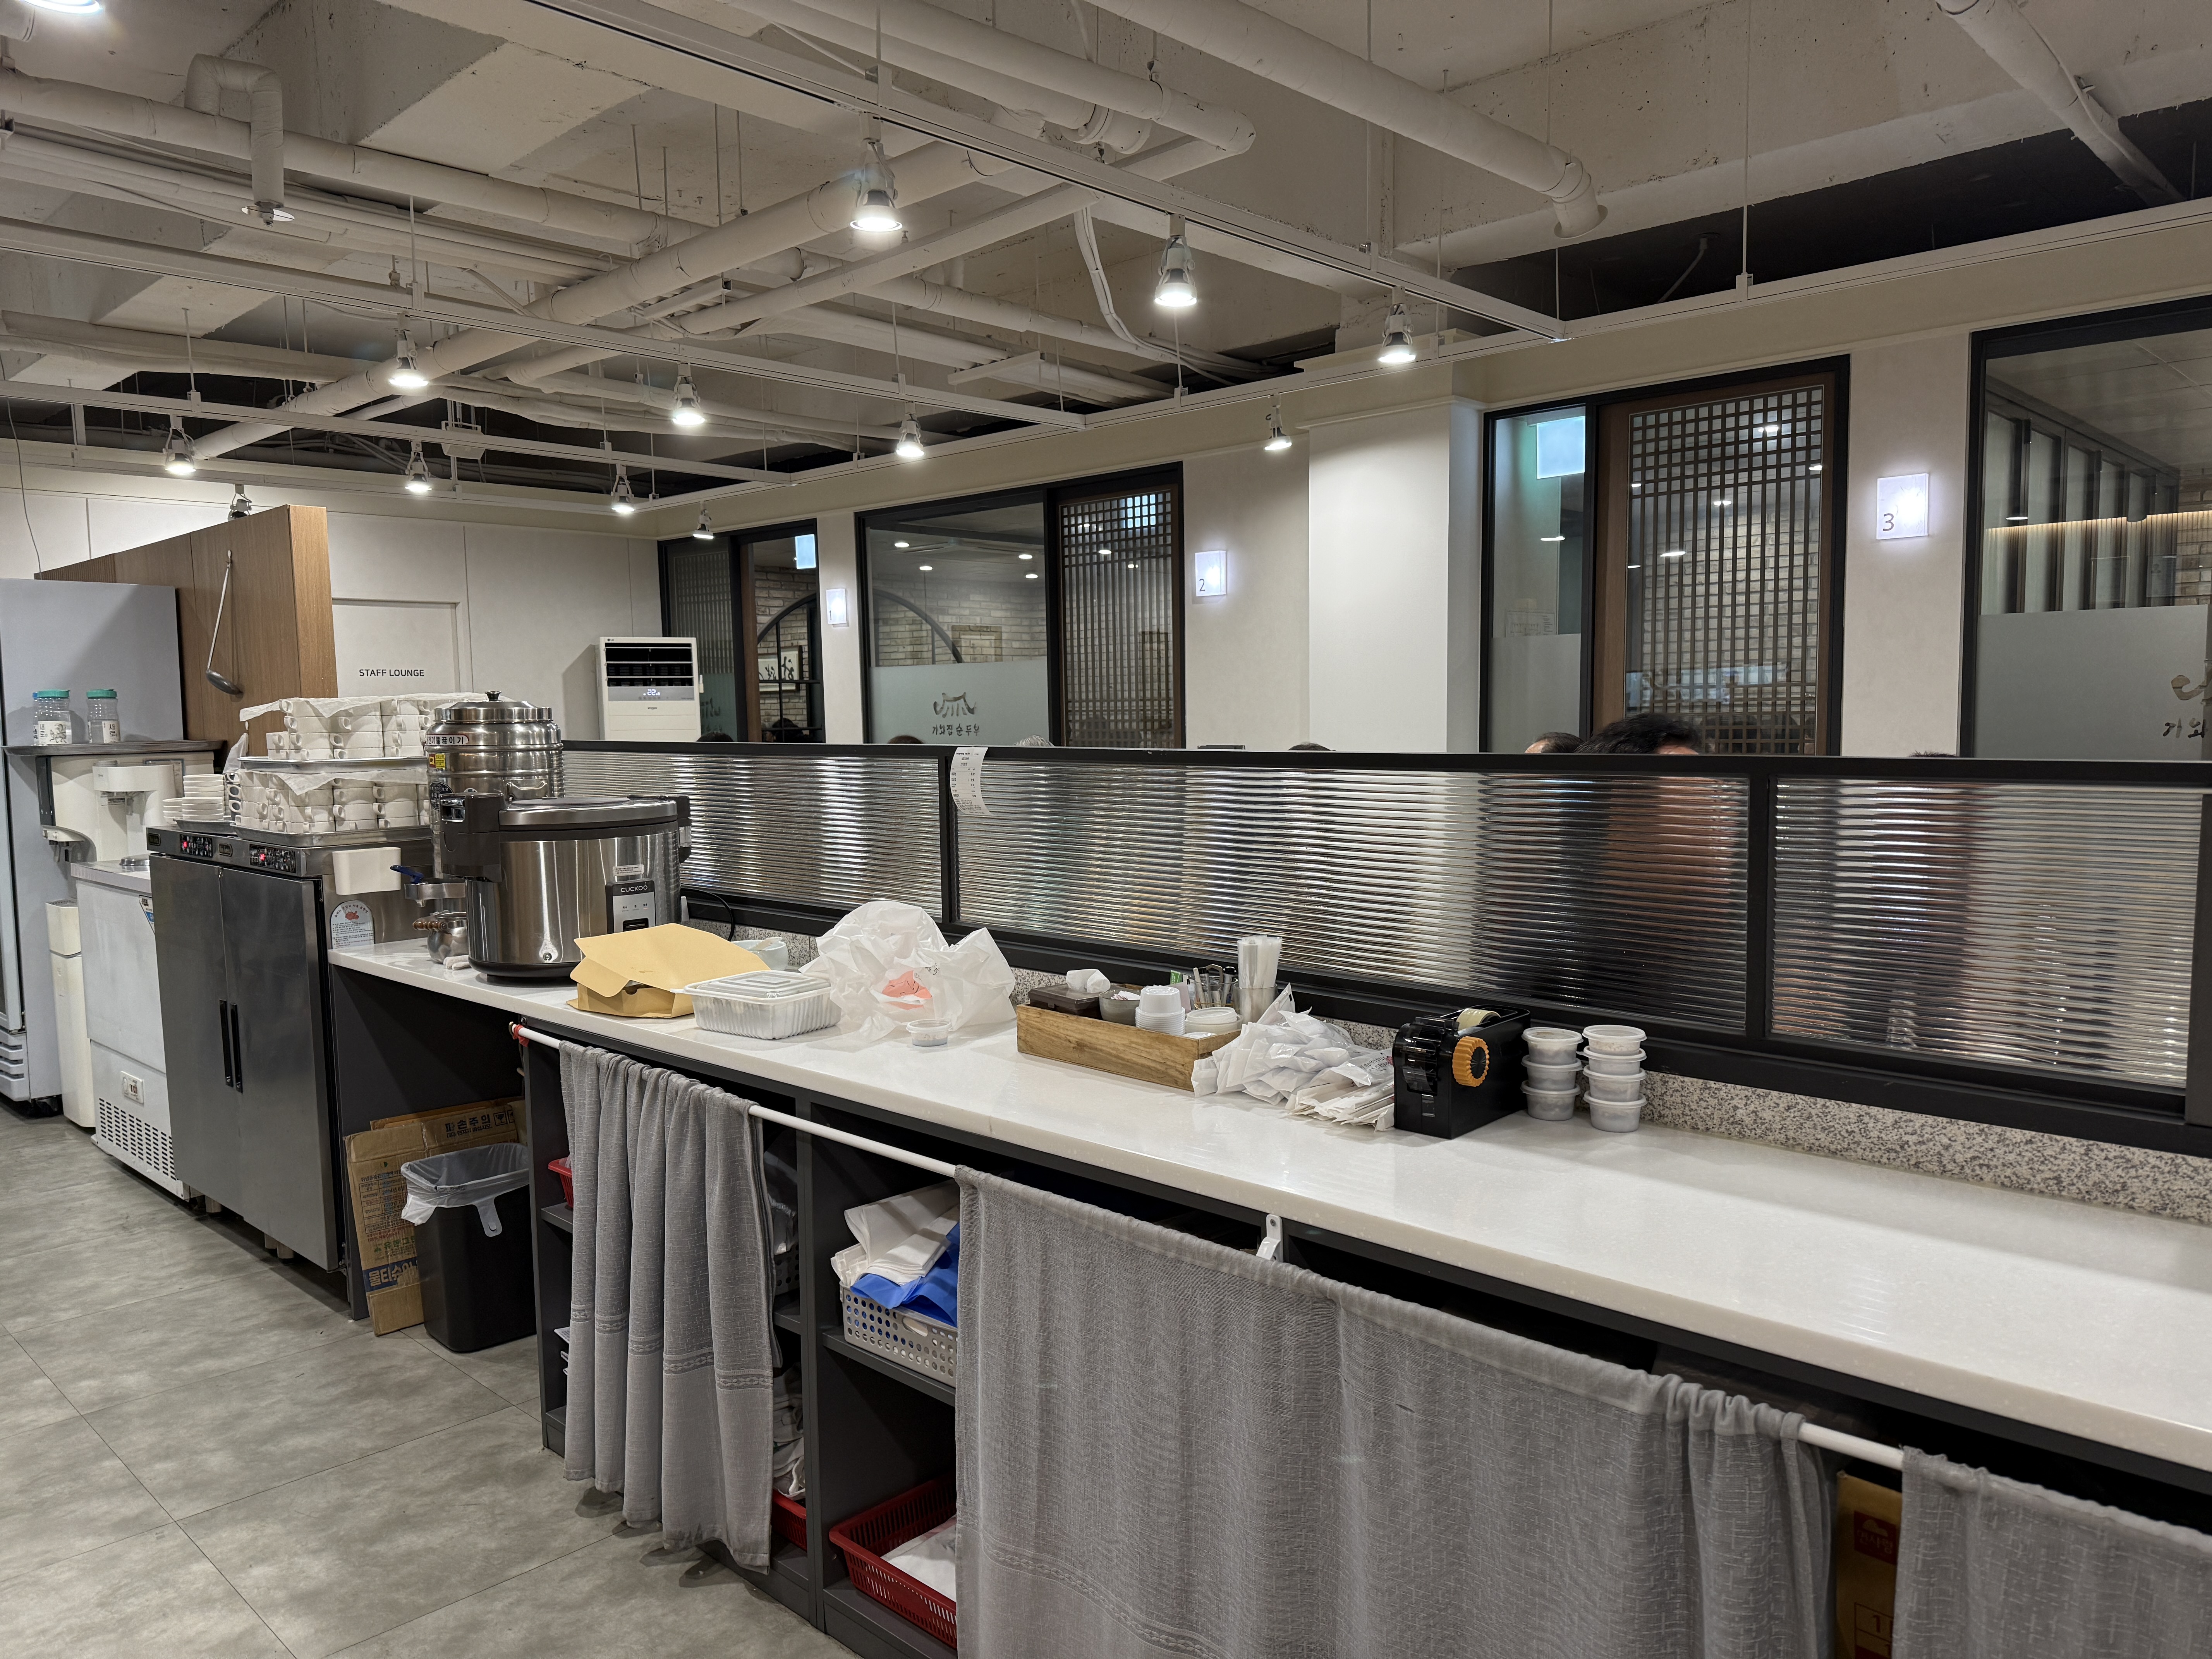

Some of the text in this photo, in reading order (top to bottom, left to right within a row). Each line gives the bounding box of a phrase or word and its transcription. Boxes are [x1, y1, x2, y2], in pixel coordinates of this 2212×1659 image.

[1883, 513, 1894, 531] 3
[1199, 579, 1205, 591] 2
[830, 610, 831, 620] 1
